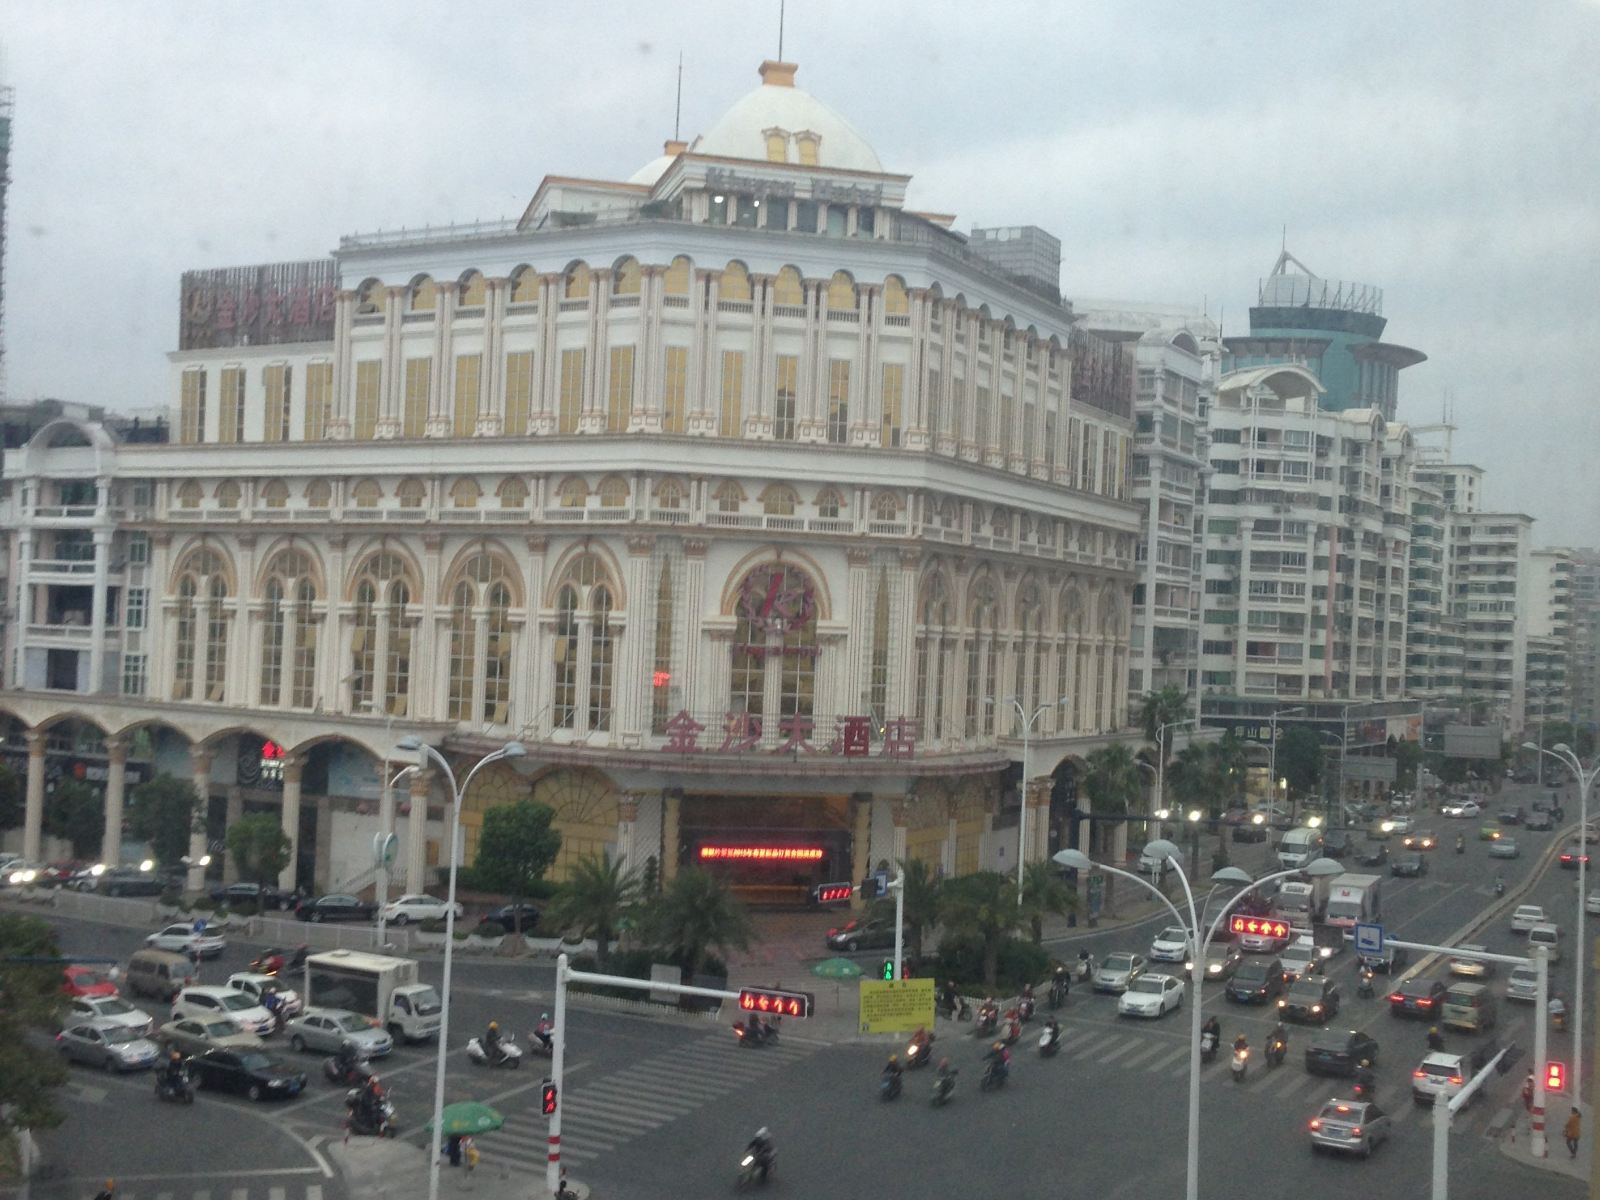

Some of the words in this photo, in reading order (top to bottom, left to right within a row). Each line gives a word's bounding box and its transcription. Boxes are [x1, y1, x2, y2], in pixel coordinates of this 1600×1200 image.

[661, 709, 924, 758] 金沙大酒店
